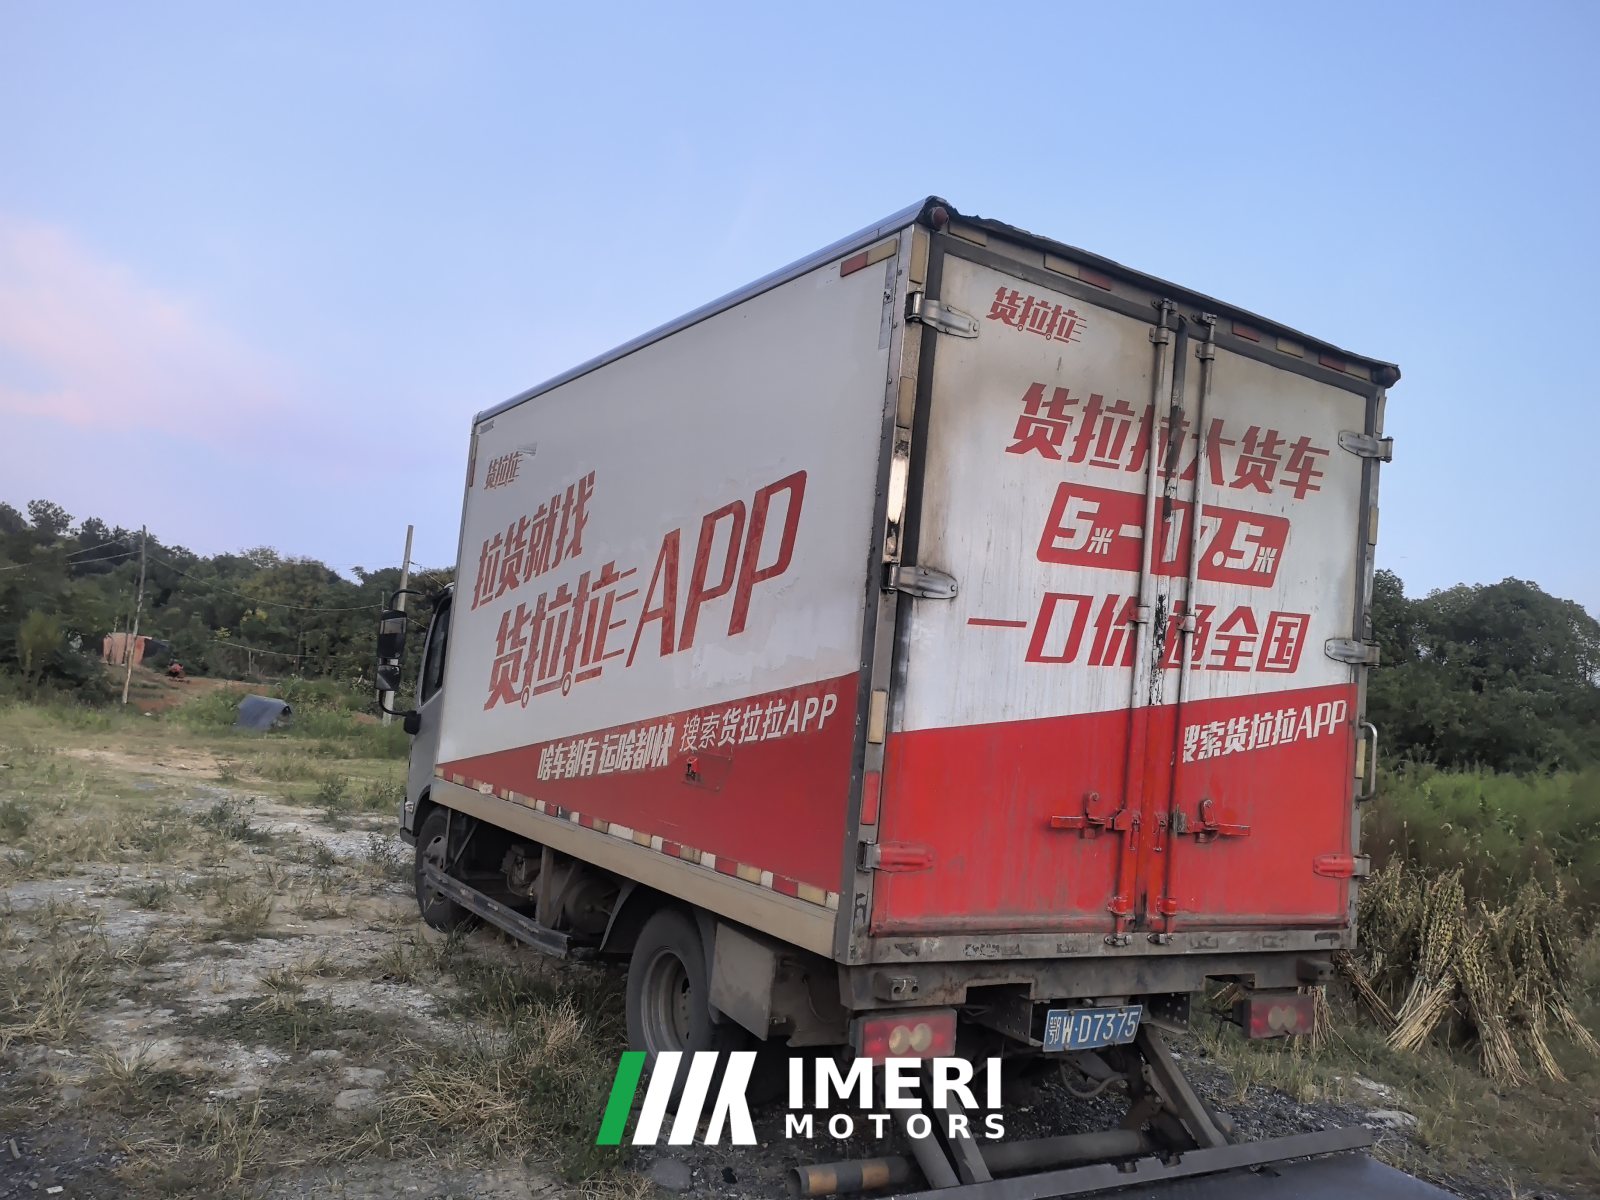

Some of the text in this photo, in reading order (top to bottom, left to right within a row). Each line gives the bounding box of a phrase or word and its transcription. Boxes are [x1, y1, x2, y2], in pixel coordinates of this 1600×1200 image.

[986, 286, 1088, 343] 货拉拉
[484, 451, 523, 490] 货拉拉
[1005, 382, 1330, 500] 货拉拉大货车
[471, 470, 596, 611] 拉货就找
